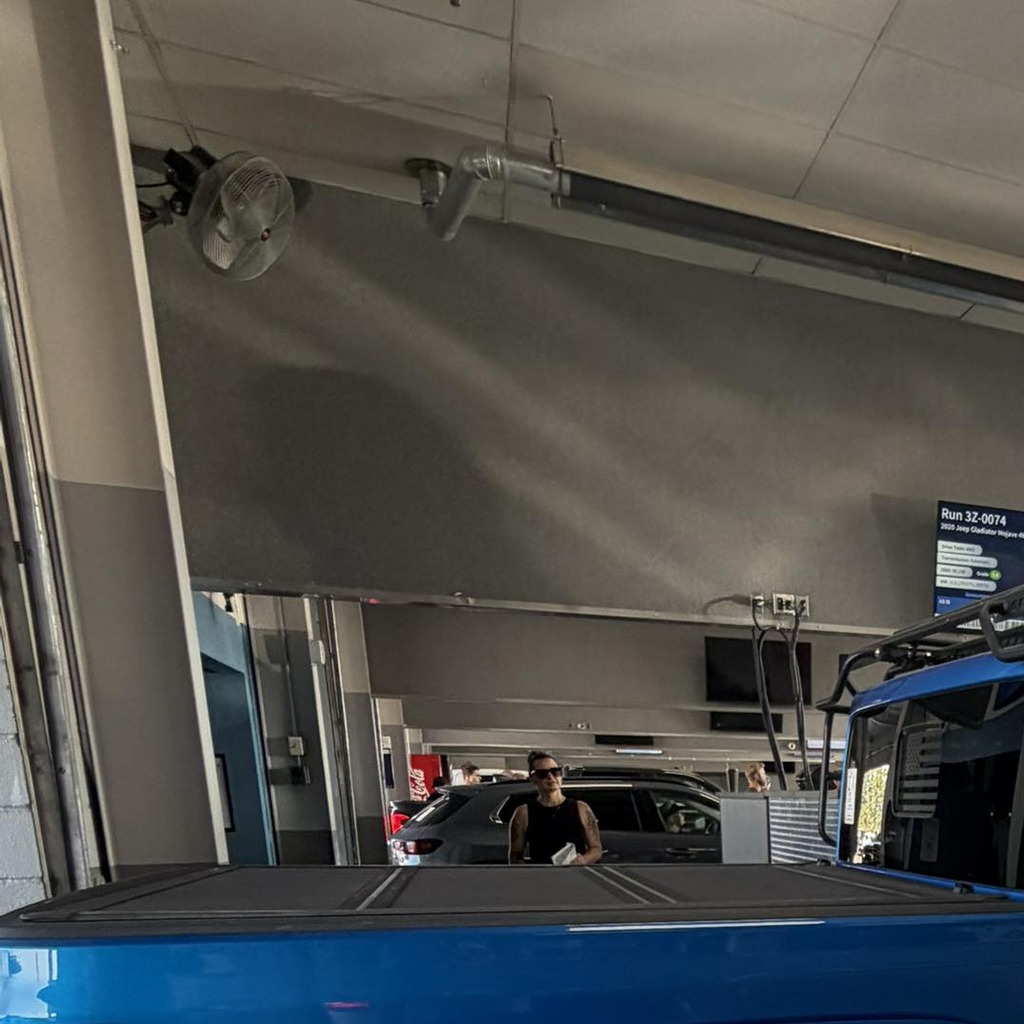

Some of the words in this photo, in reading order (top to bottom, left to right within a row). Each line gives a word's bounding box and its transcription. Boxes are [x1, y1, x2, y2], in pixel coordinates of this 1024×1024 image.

[941, 507, 963, 521] Run
[964, 510, 1007, 527] 3Z-0074
[956, 524, 970, 534] Jeep
[970, 526, 998, 536] Gladiator
